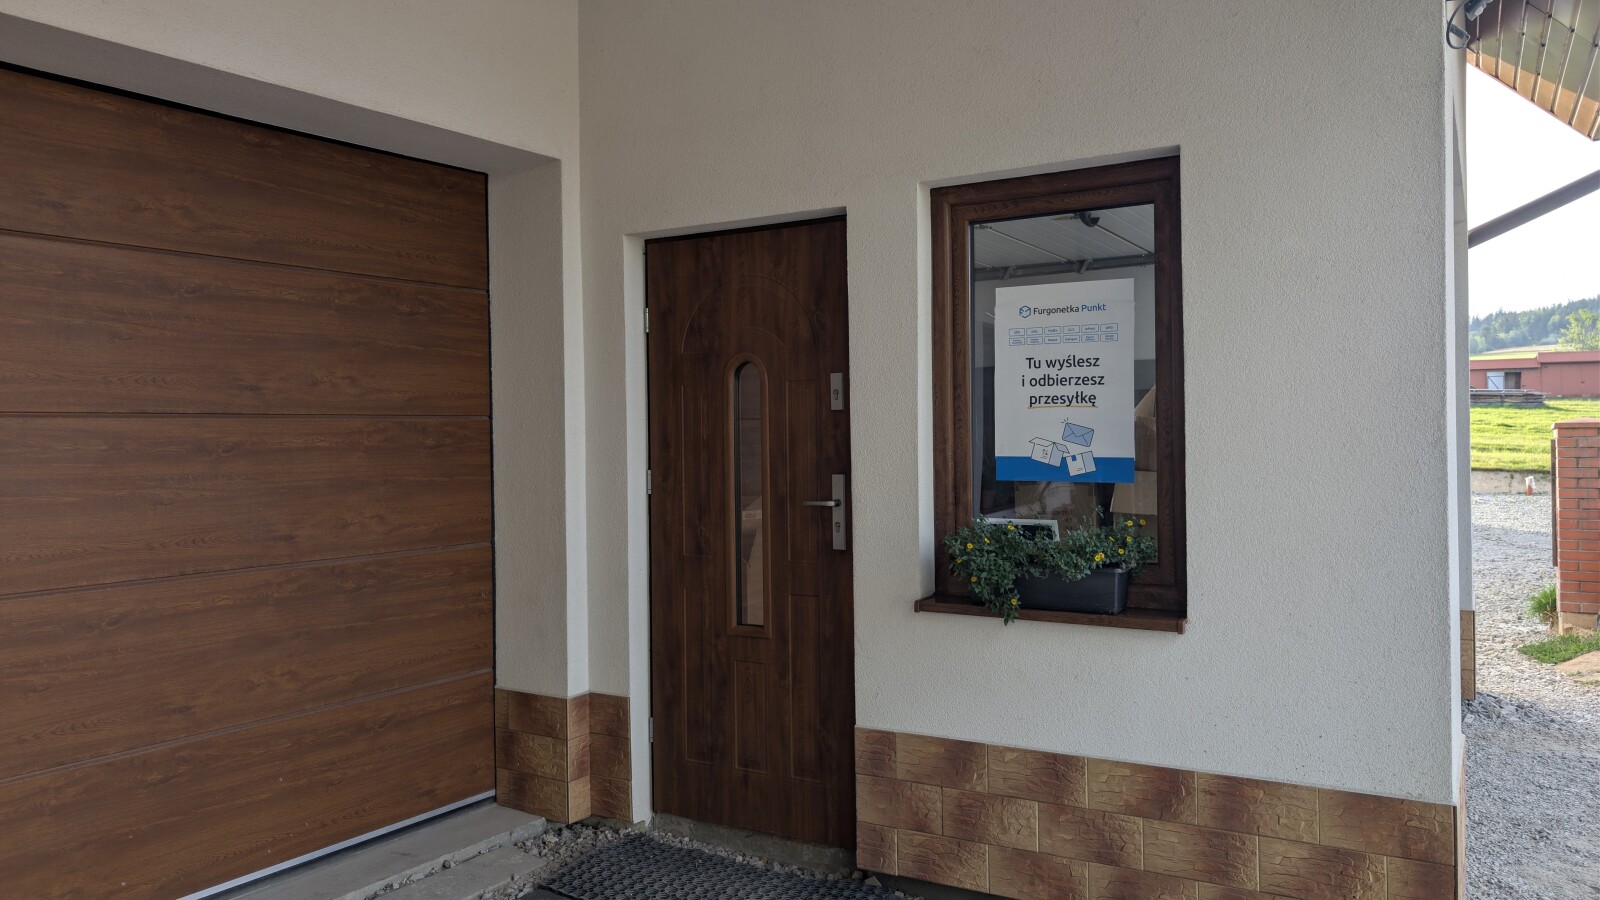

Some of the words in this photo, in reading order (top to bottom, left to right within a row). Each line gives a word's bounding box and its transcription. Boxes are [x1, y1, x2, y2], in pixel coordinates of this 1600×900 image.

[1033, 305, 1080, 316] Furgonetka
[1081, 303, 1107, 312] Punkt
[1025, 357, 1042, 370] Tu
[1045, 354, 1101, 371] wyślesz
[1021, 374, 1026, 388] i
[1029, 373, 1105, 387] odbierzesz
[1029, 390, 1097, 408] przesyłkę
